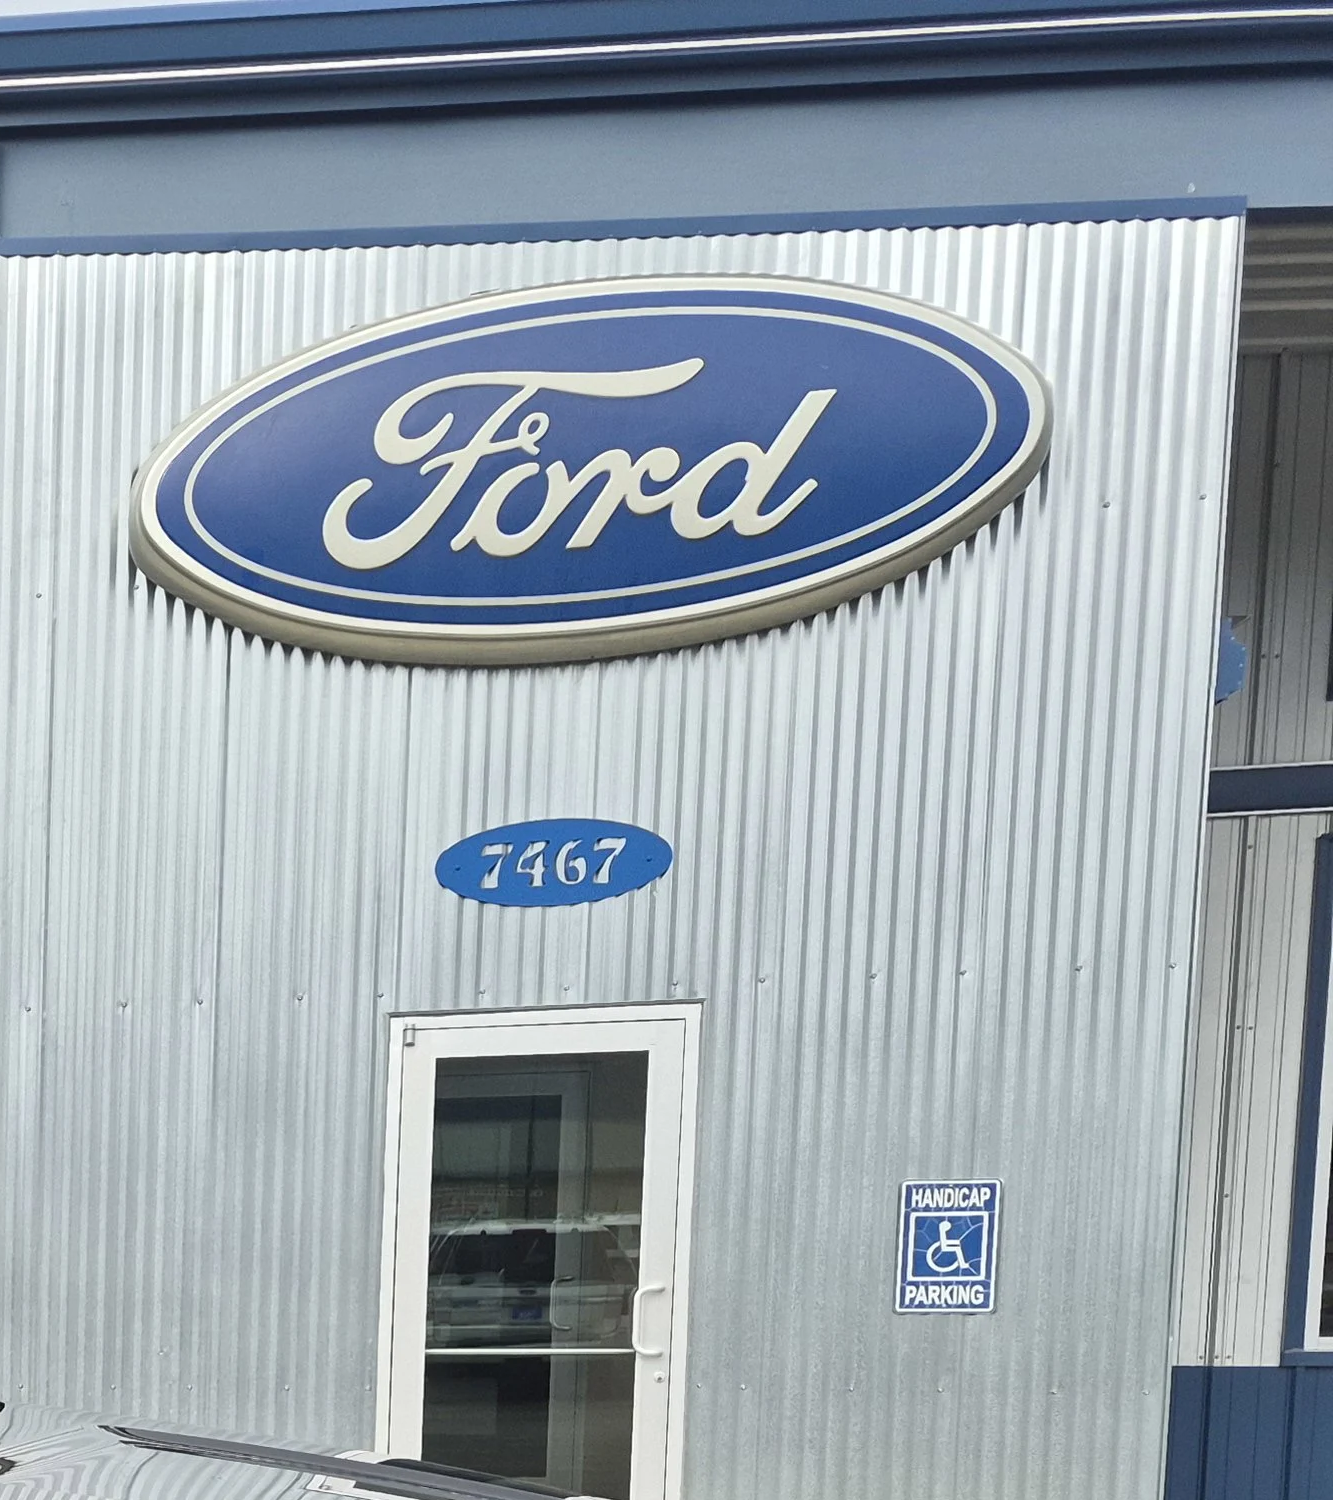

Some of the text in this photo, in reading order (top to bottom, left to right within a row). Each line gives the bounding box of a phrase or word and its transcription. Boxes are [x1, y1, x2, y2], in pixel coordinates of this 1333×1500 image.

[322, 357, 837, 569] Ford
[481, 836, 627, 889] 7467
[911, 1186, 991, 1208] HANDICAP
[904, 1284, 985, 1306] PARKING
